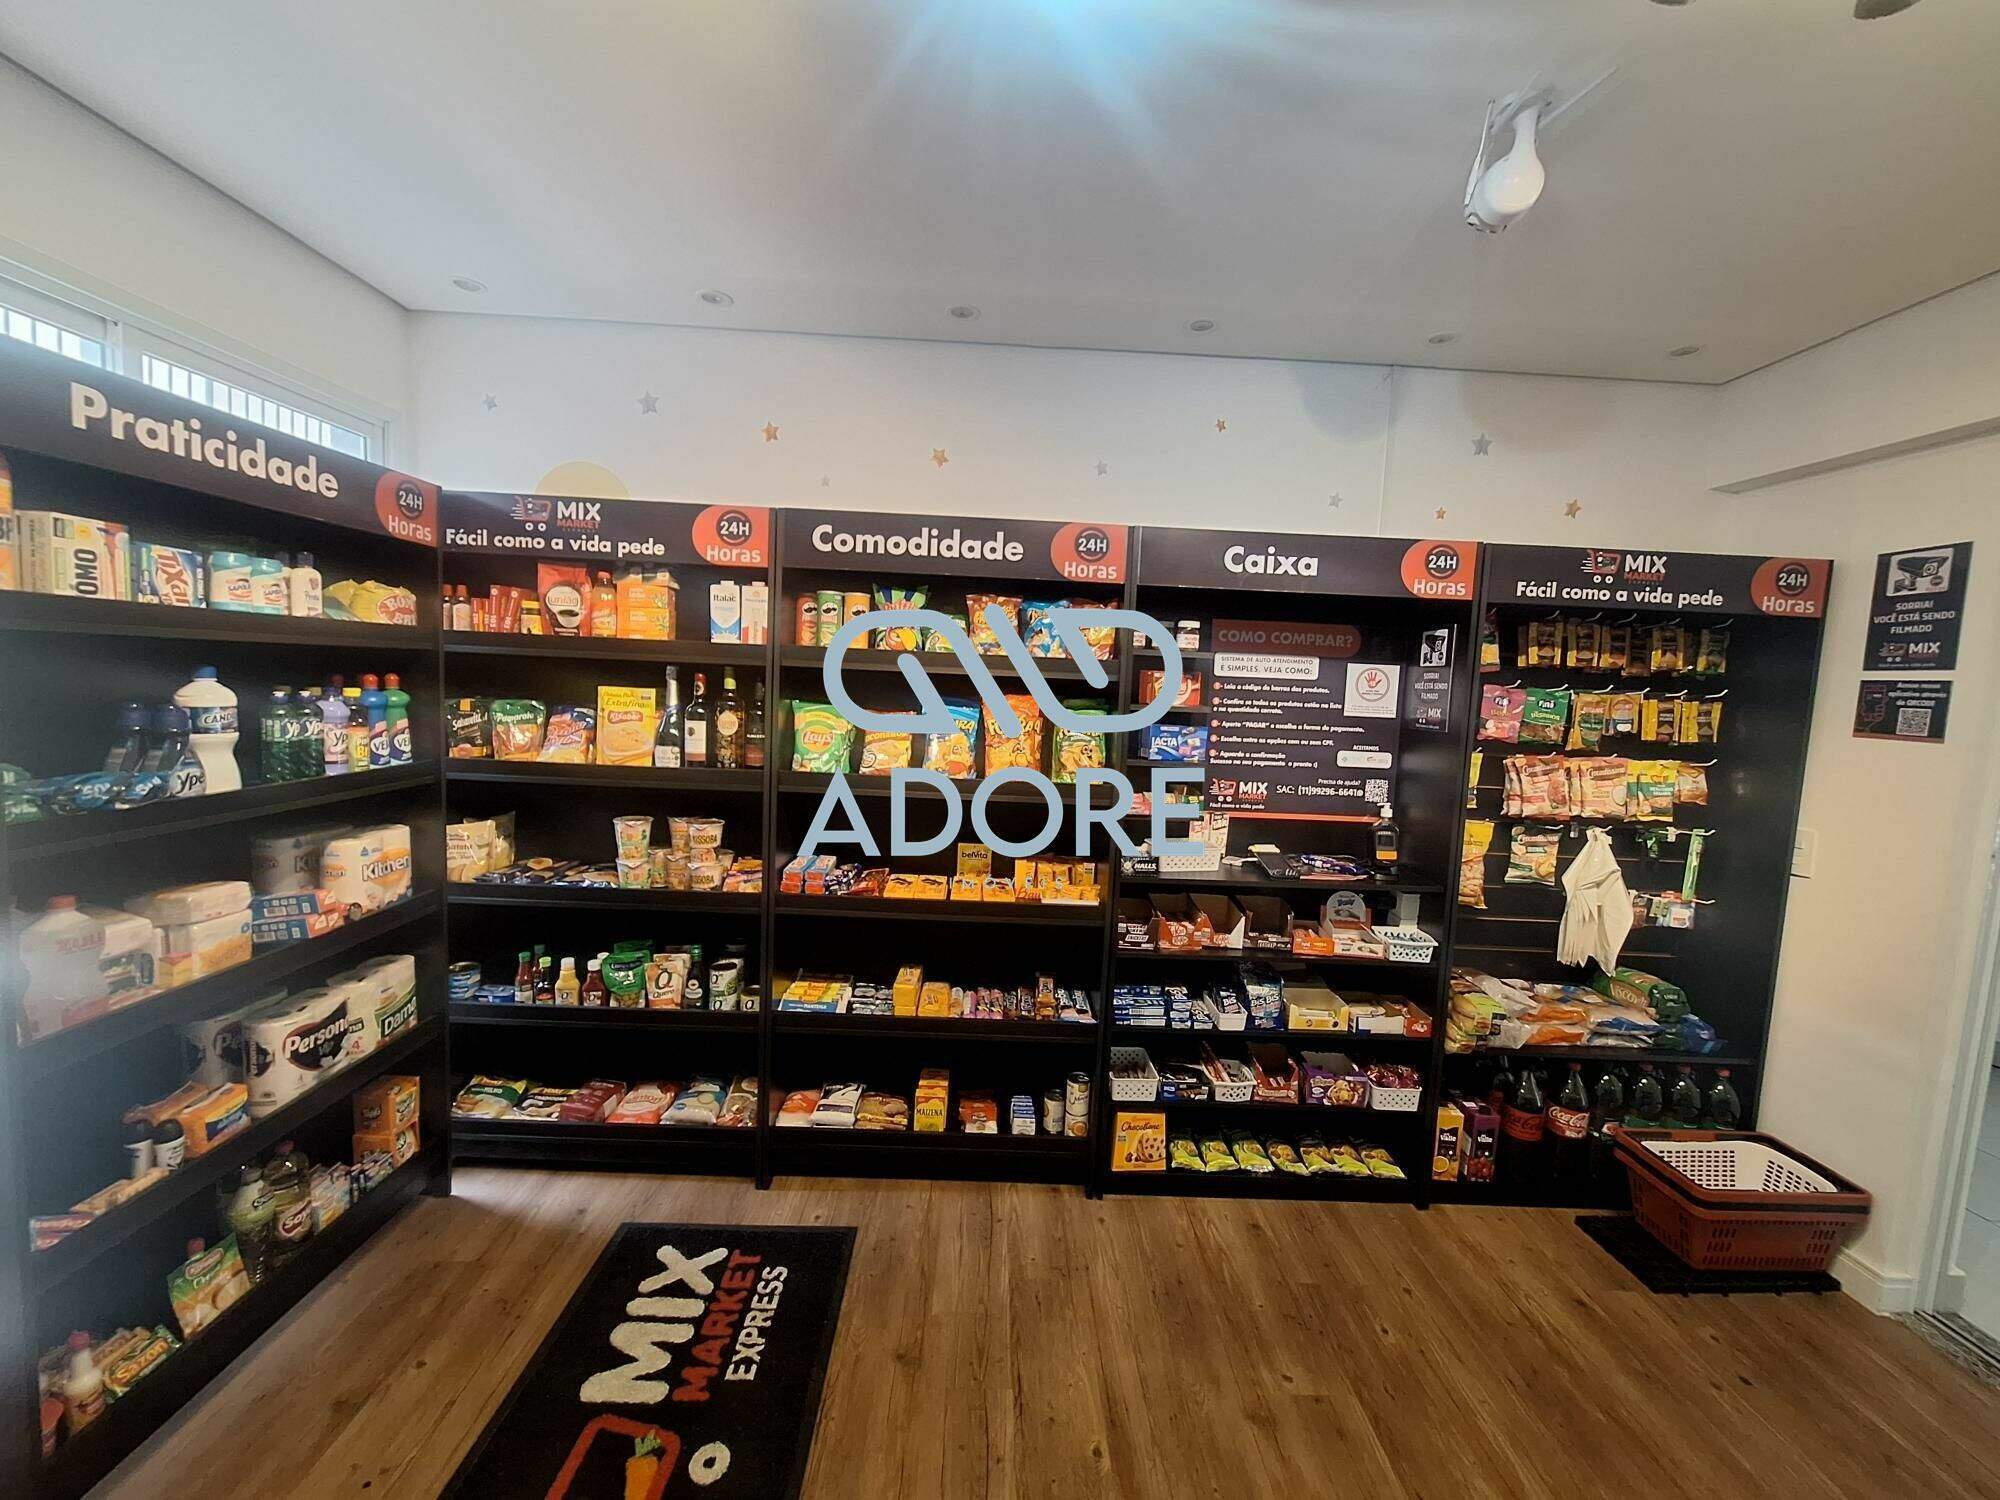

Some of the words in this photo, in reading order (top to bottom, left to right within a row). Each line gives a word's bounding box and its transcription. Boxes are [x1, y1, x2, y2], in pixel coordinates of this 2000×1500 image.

[70, 382, 339, 499] Praticidade
[399, 490, 423, 511] 24H
[556, 501, 601, 521] MIX
[388, 514, 432, 542] Horas
[556, 519, 601, 529] MARKET
[719, 521, 750, 537] 24H
[446, 528, 488, 547] Fácil
[493, 534, 546, 549] como
[550, 537, 564, 550] a
[569, 535, 612, 553] vida
[617, 538, 666, 558] pede
[811, 524, 1024, 562] Comodidade
[1077, 538, 1107, 553] 24H
[707, 544, 761, 563] Horas
[1223, 545, 1319, 577] Caixa
[1428, 555, 1457, 570] 24H
[1063, 561, 1118, 579] Horas
[1624, 554, 1668, 573] MIX
[1624, 572, 1665, 582] MARKET
[1778, 572, 1807, 588] 24H
[1413, 578, 1466, 596] Horas
[1516, 580, 1557, 598] Fácil
[1561, 587, 1611, 601] como
[1615, 589, 1628, 602] a
[1633, 587, 1673, 604] vida
[1677, 590, 1723, 608] pede
[1762, 596, 1815, 614] Horas
[1896, 600, 1934, 611] SORRIA!
[1873, 611, 1896, 624] VOCÊ
[1898, 611, 1920, 622] ESTÁ
[1922, 610, 1955, 621] SENDO
[1890, 624, 1933, 634] FILMADO
[1218, 629, 1266, 644] COMO
[1270, 631, 1353, 648] COMPRAR?
[1908, 642, 1940, 654] MIX
[1285, 667, 1313, 675] COMO:
[1427, 708, 1442, 718] MIX
[1151, 737, 1178, 747] LACTA
[1238, 781, 1268, 795] MIX
[1276, 784, 1295, 794] SAC:
[916, 1108, 943, 1117] MAIZENA
[579, 1244, 729, 1404] MIX
[672, 1248, 762, 1402] MARKET
[724, 1265, 789, 1382] EXPRESS
